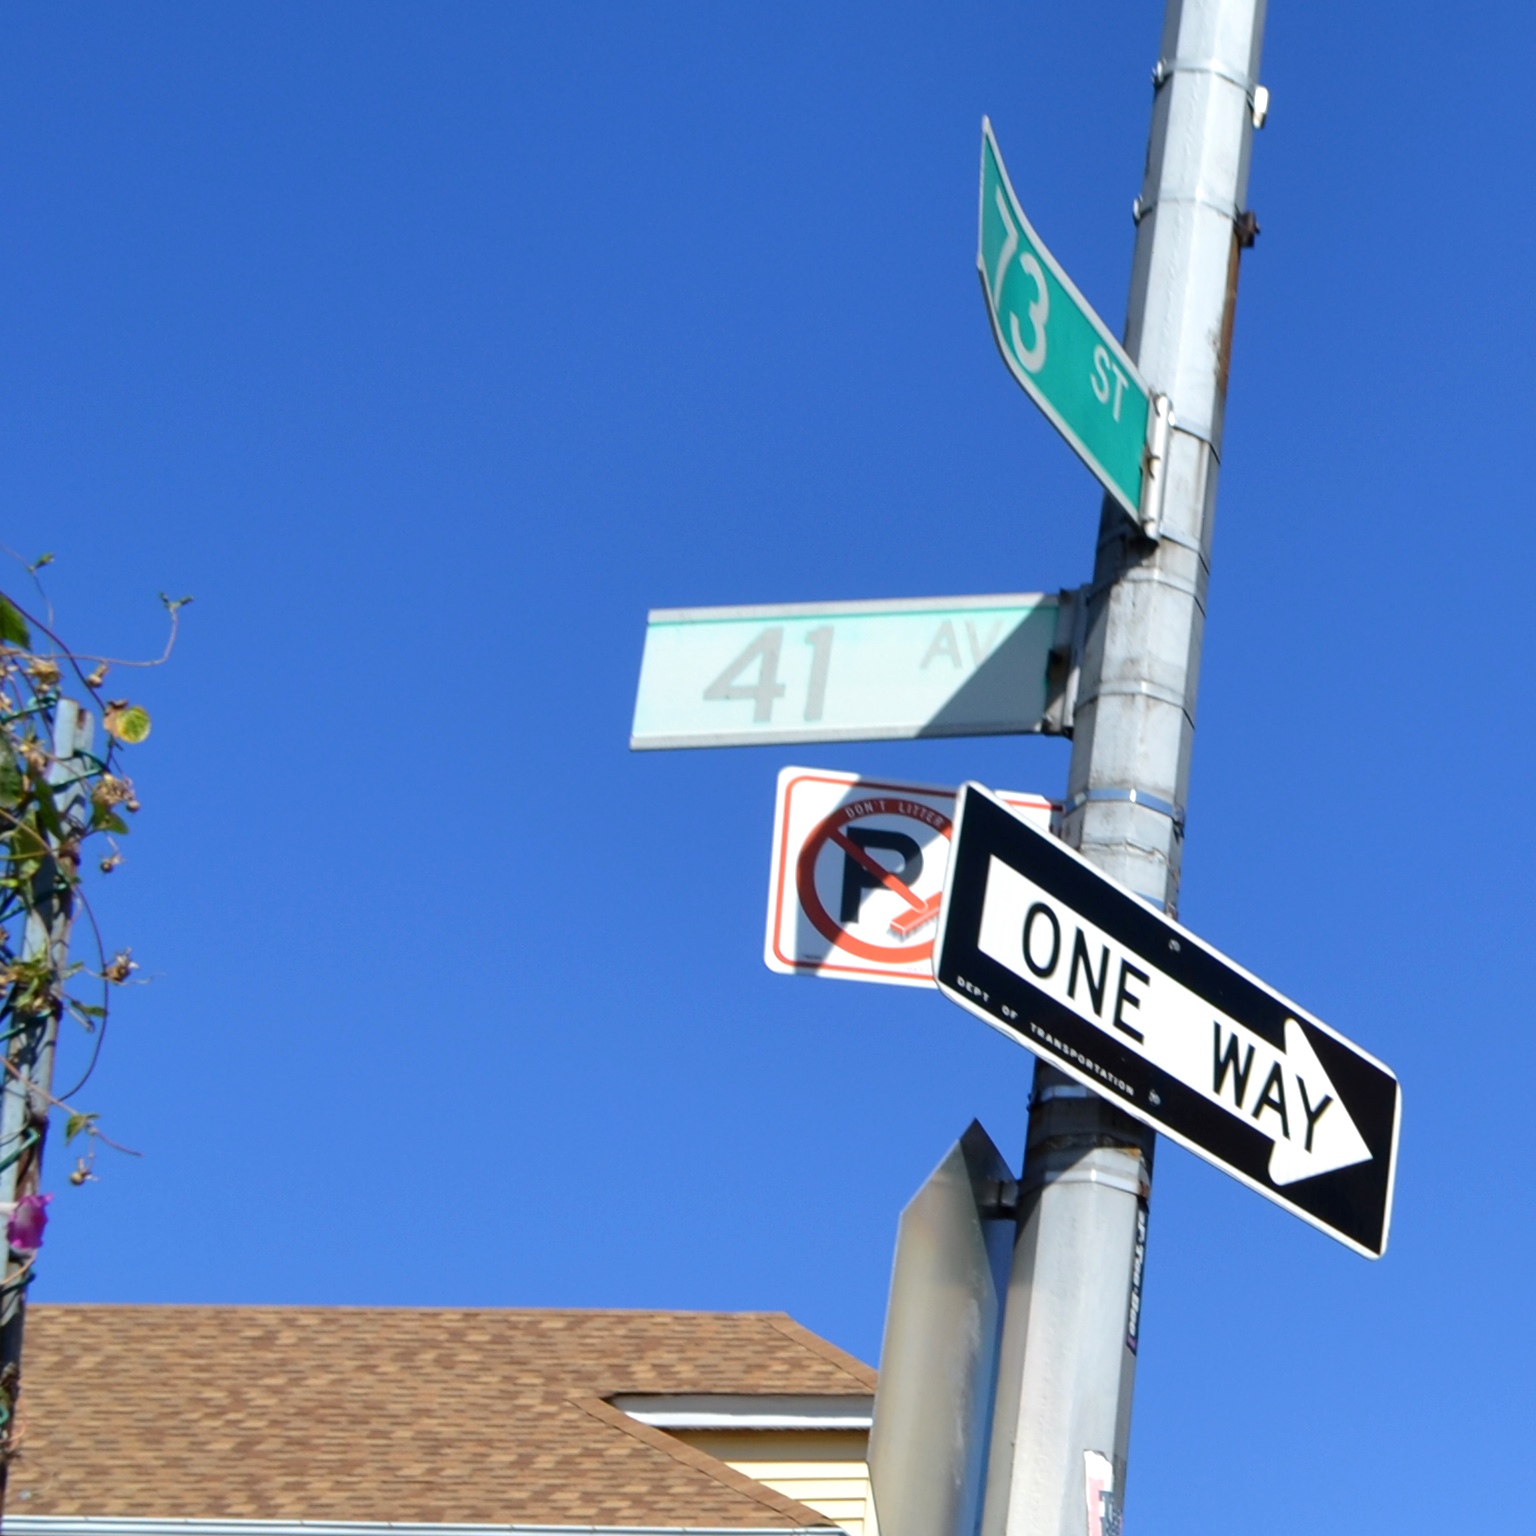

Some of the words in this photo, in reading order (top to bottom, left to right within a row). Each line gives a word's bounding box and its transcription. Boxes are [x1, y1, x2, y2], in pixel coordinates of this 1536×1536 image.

[994, 184, 1050, 373] 73
[1090, 344, 1128, 422] ST
[703, 624, 835, 725] 41
[919, 618, 1004, 670] AV
[845, 799, 887, 819] DON'T
[897, 801, 946, 828] LITTER
[956, 975, 991, 1003] DEPT
[1001, 1004, 1019, 1020] OF
[1030, 1021, 1135, 1097] TRANSPORTATION
[1022, 901, 1151, 1047] ONE
[1213, 1020, 1334, 1154] WAY
